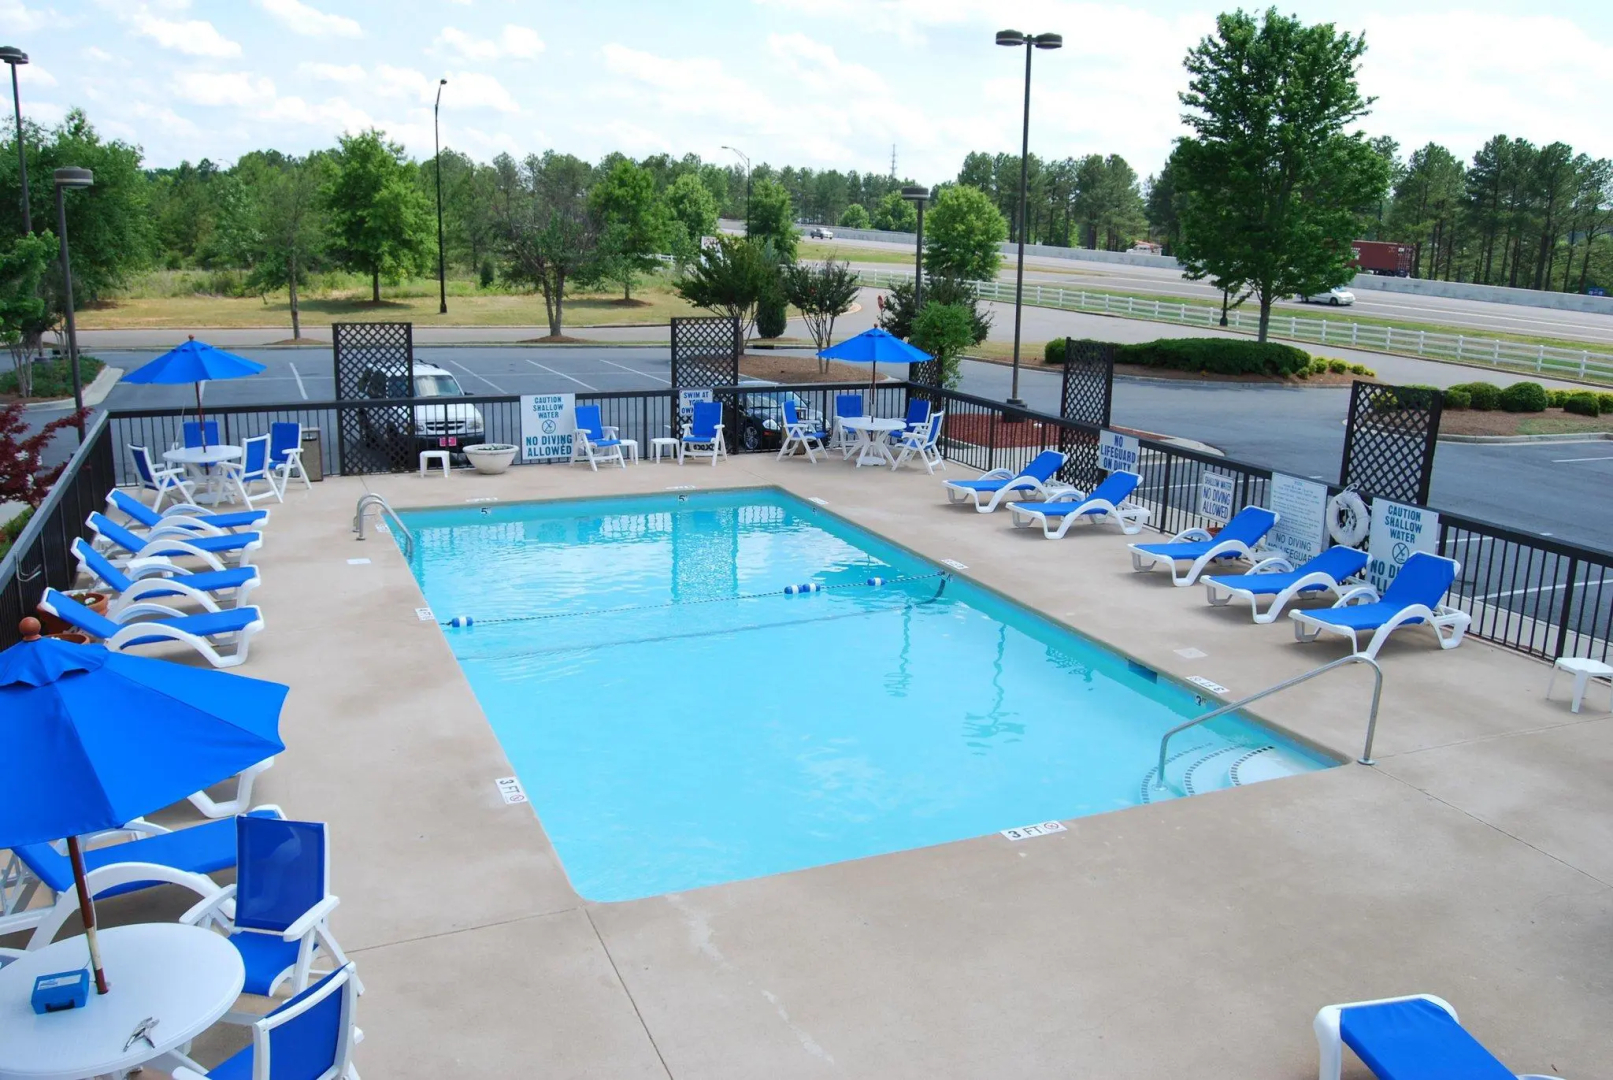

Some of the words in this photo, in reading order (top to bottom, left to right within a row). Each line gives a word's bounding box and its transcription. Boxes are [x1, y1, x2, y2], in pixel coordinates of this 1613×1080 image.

[534, 396, 562, 404] CAUTION
[683, 391, 700, 399] SWIM
[532, 404, 564, 412] SHALLOW
[538, 411, 560, 419] WATER
[526, 436, 538, 446] NO
[541, 434, 573, 446] DIVING
[1114, 434, 1124, 448] NO
[527, 445, 572, 457] ALLOWED
[1100, 443, 1136, 464] LIFEGUARD
[1103, 456, 1113, 469] ON
[1113, 460, 1131, 472] DUTY
[1203, 486, 1212, 499] NO
[1212, 489, 1231, 506] DIVING
[1202, 500, 1229, 519] ALLOWED
[1388, 504, 1421, 522] CAUTION
[1384, 515, 1422, 534] SHALLOW
[1275, 532, 1286, 544] NO
[1288, 536, 1312, 552] DIVING
[1389, 528, 1415, 544] WATER
[1370, 559, 1385, 576] NO
[1008, 830, 1022, 838] 3
[1022, 825, 1043, 836] FT
